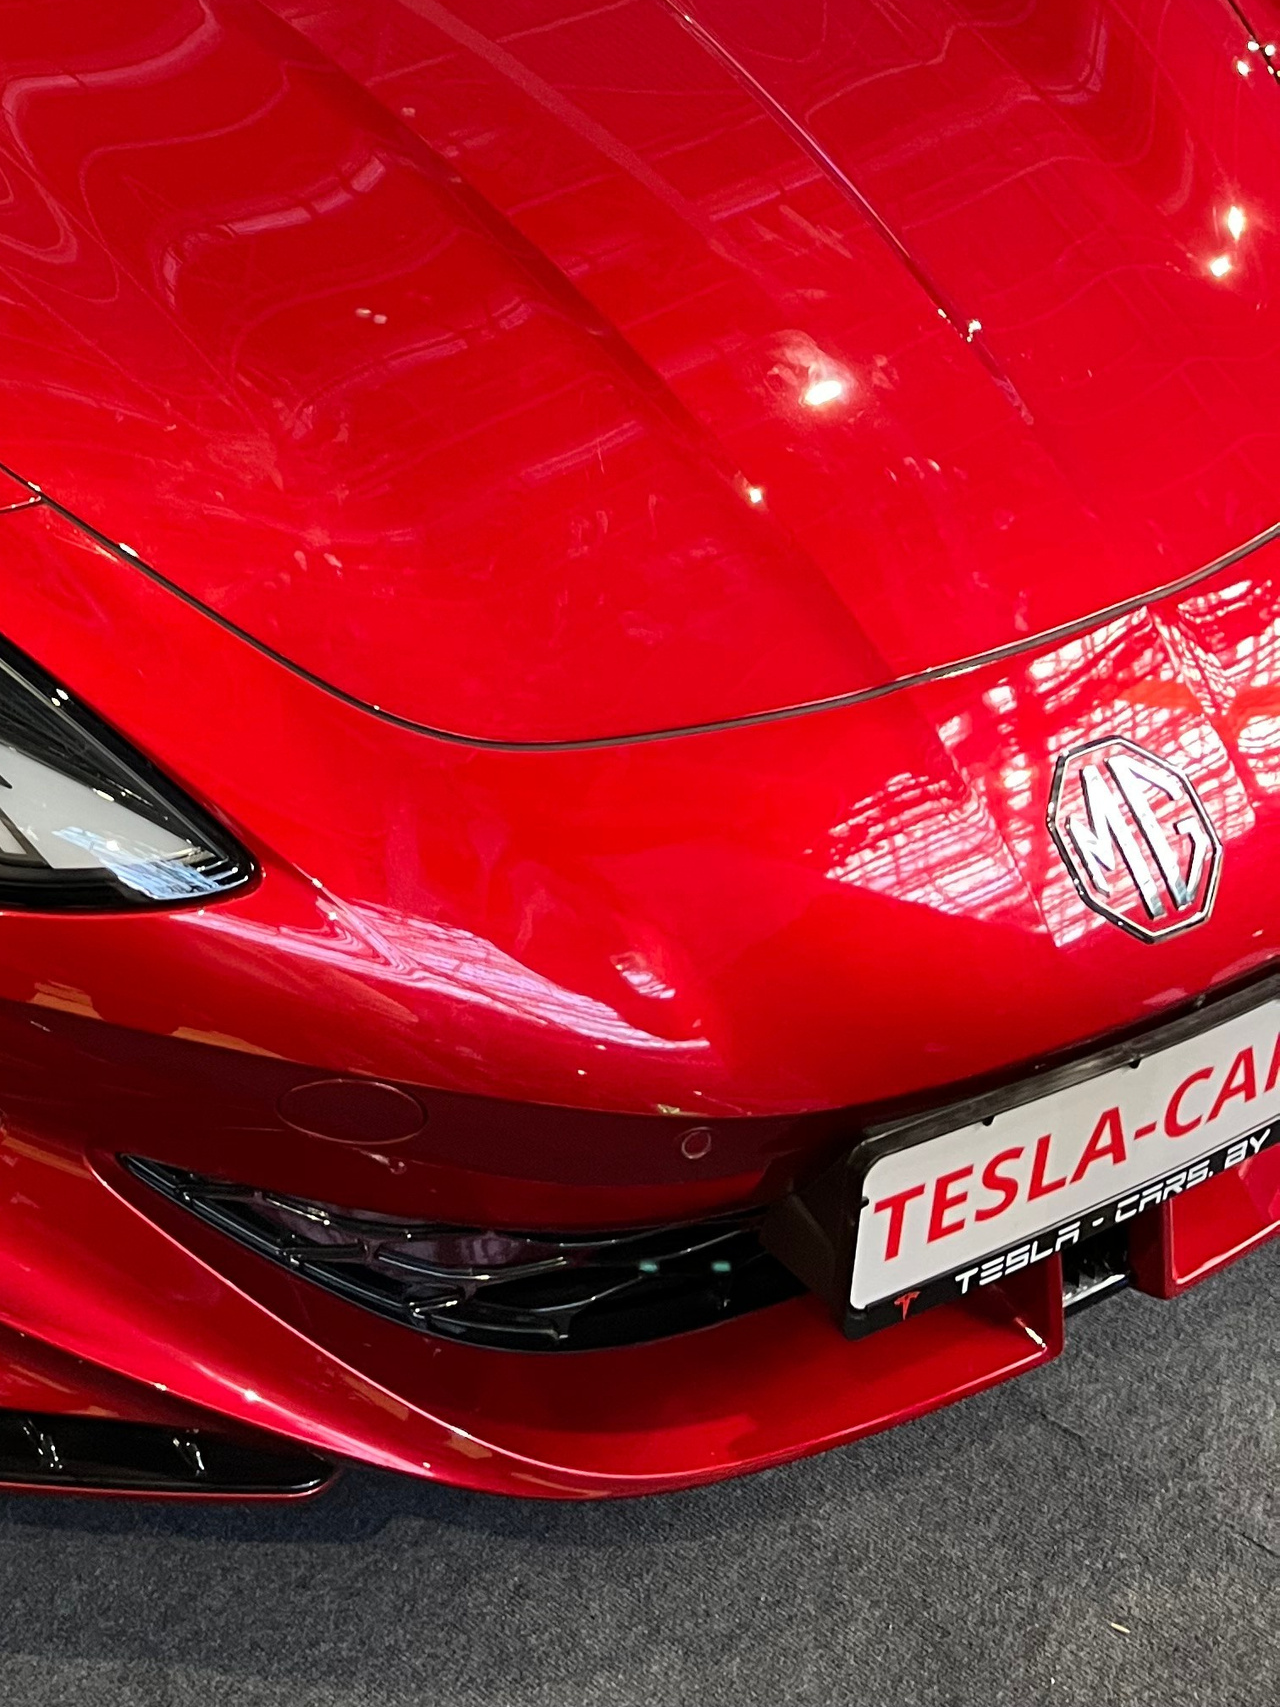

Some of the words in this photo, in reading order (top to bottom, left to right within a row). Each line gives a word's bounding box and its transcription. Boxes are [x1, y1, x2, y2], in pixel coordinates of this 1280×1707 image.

[1064, 753, 1211, 921] MG
[955, 1221, 1081, 1295] TESLA
[1224, 1128, 1272, 1170] BY
